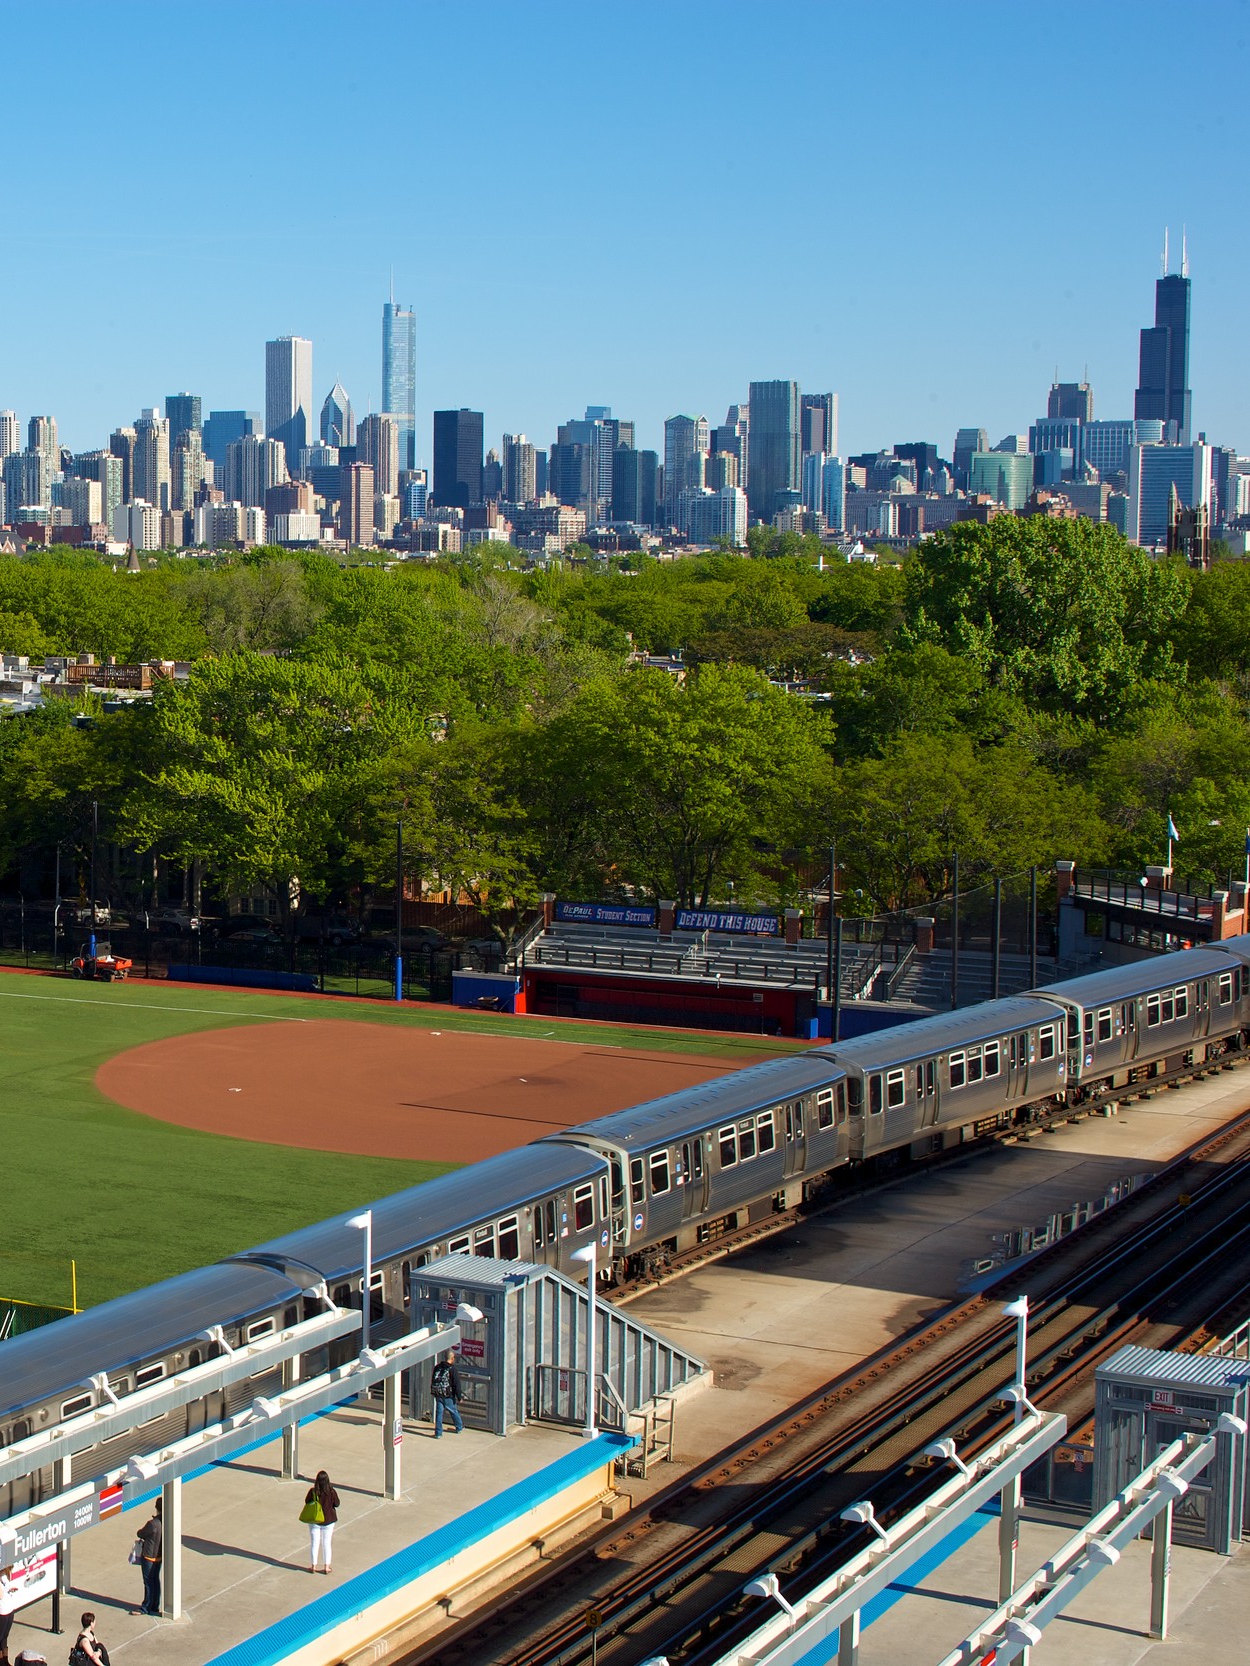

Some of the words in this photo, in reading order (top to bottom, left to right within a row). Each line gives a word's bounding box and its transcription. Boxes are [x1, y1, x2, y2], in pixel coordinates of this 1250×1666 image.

[719, 915, 743, 929] THIS
[744, 917, 778, 932] HOUSE
[1155, 1391, 1168, 1402] EXIT
[396, 1420, 401, 1432] F
[75, 1503, 93, 1519] 2400N
[74, 1512, 93, 1528] 1000W
[14, 1519, 66, 1556] Fullerton
[590, 1614, 597, 1624] 8
